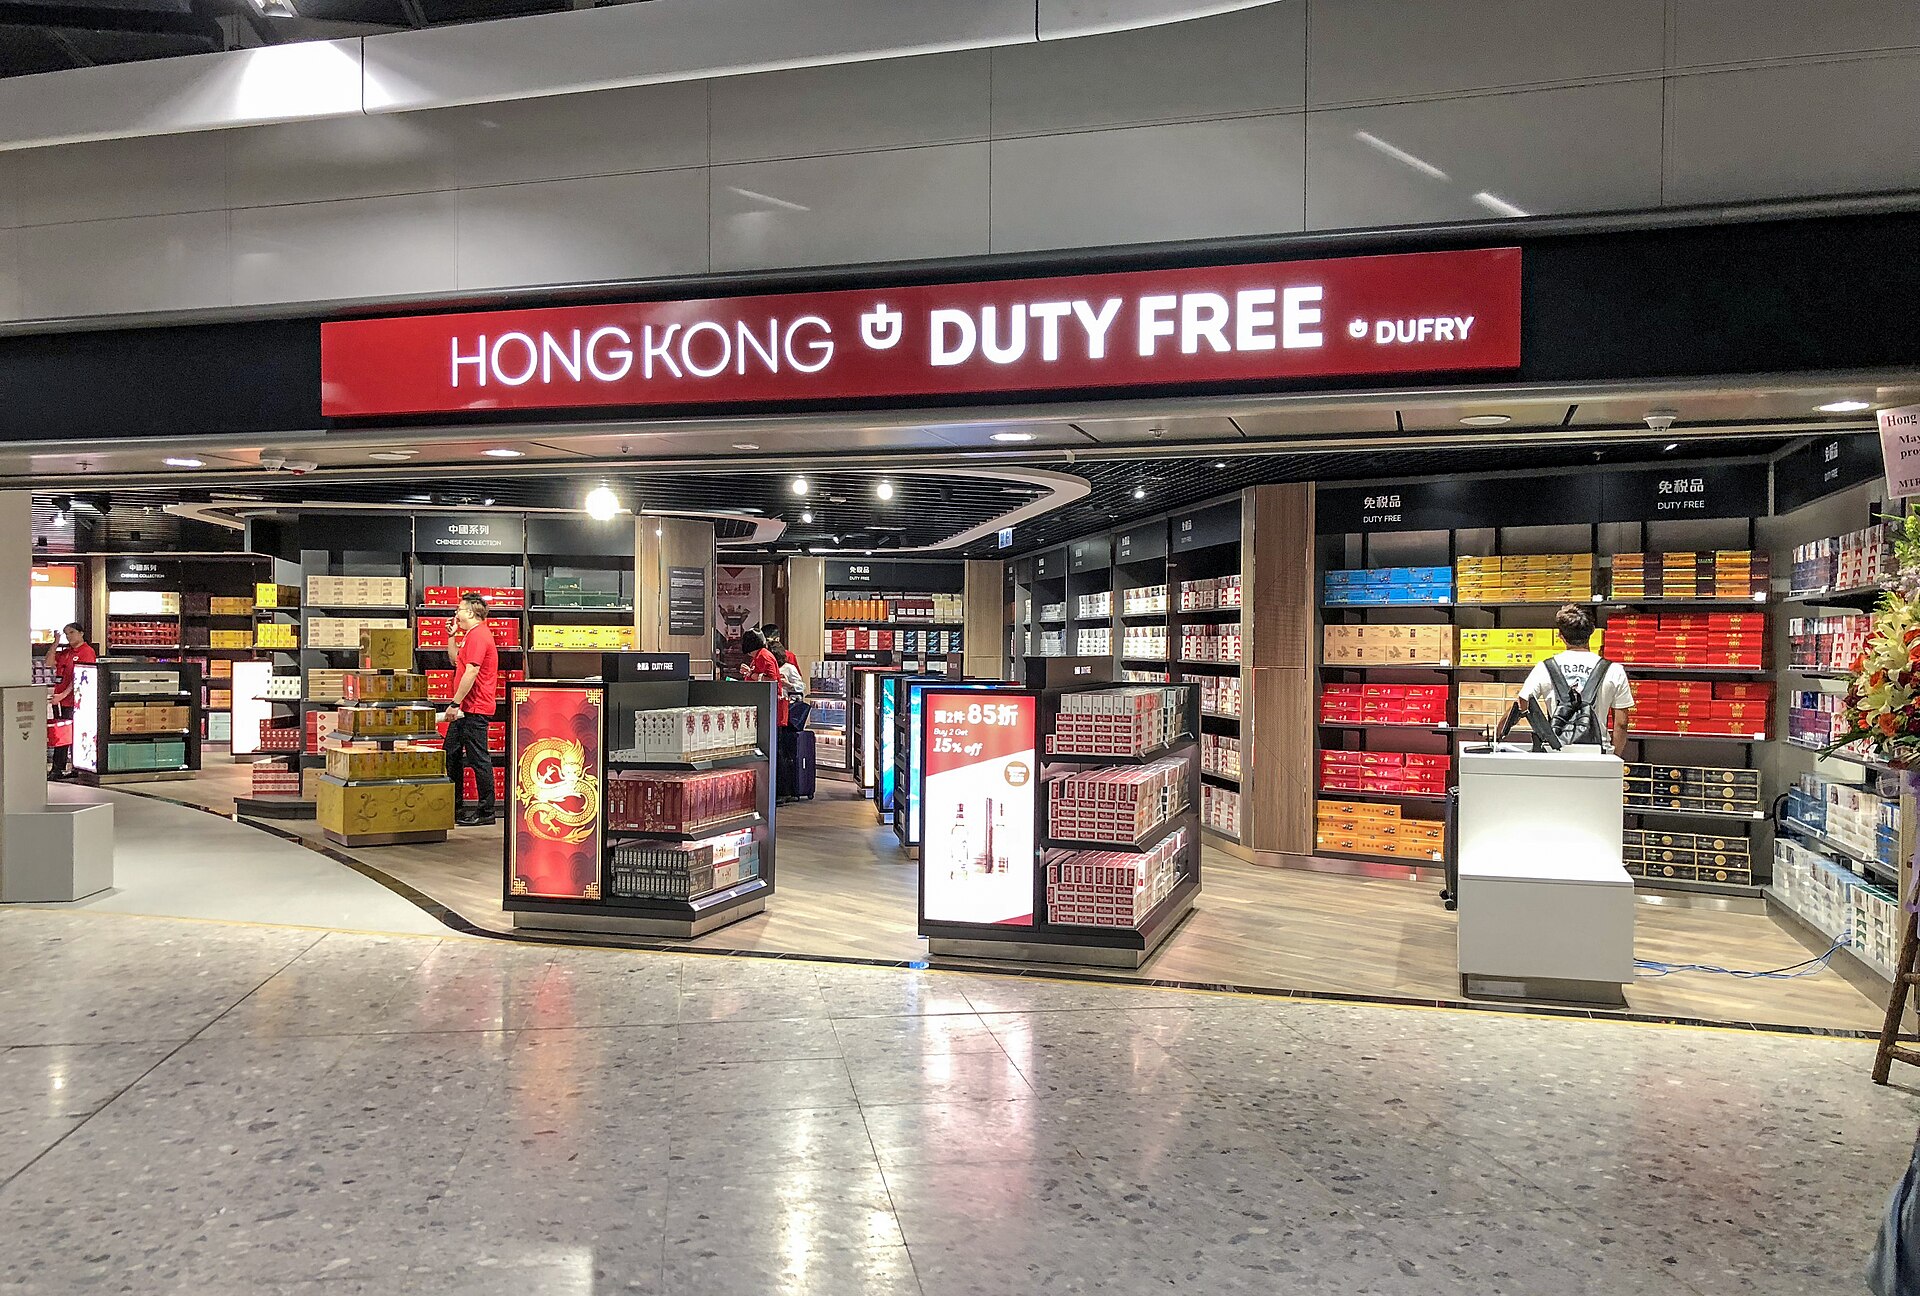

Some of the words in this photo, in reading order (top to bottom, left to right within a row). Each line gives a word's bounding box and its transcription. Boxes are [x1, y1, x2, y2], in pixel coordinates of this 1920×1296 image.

[930, 297, 1122, 367] DUTY
[1138, 286, 1324, 357] FREE
[1375, 316, 1474, 345] DUFRY
[1887, 414, 1917, 427] Hong
[1900, 448, 1920, 460] pro
[1657, 501, 1681, 510] DUTY
[1683, 500, 1705, 509] FREE
[1363, 515, 1383, 523] DUTY
[1384, 514, 1401, 522] FREE
[435, 538, 462, 546] CHINESE
[933, 728, 947, 737] Buy
[949, 728, 954, 736] 2
[955, 728, 969, 736] Get
[933, 738, 963, 753] 15%
[964, 743, 983, 756] off
